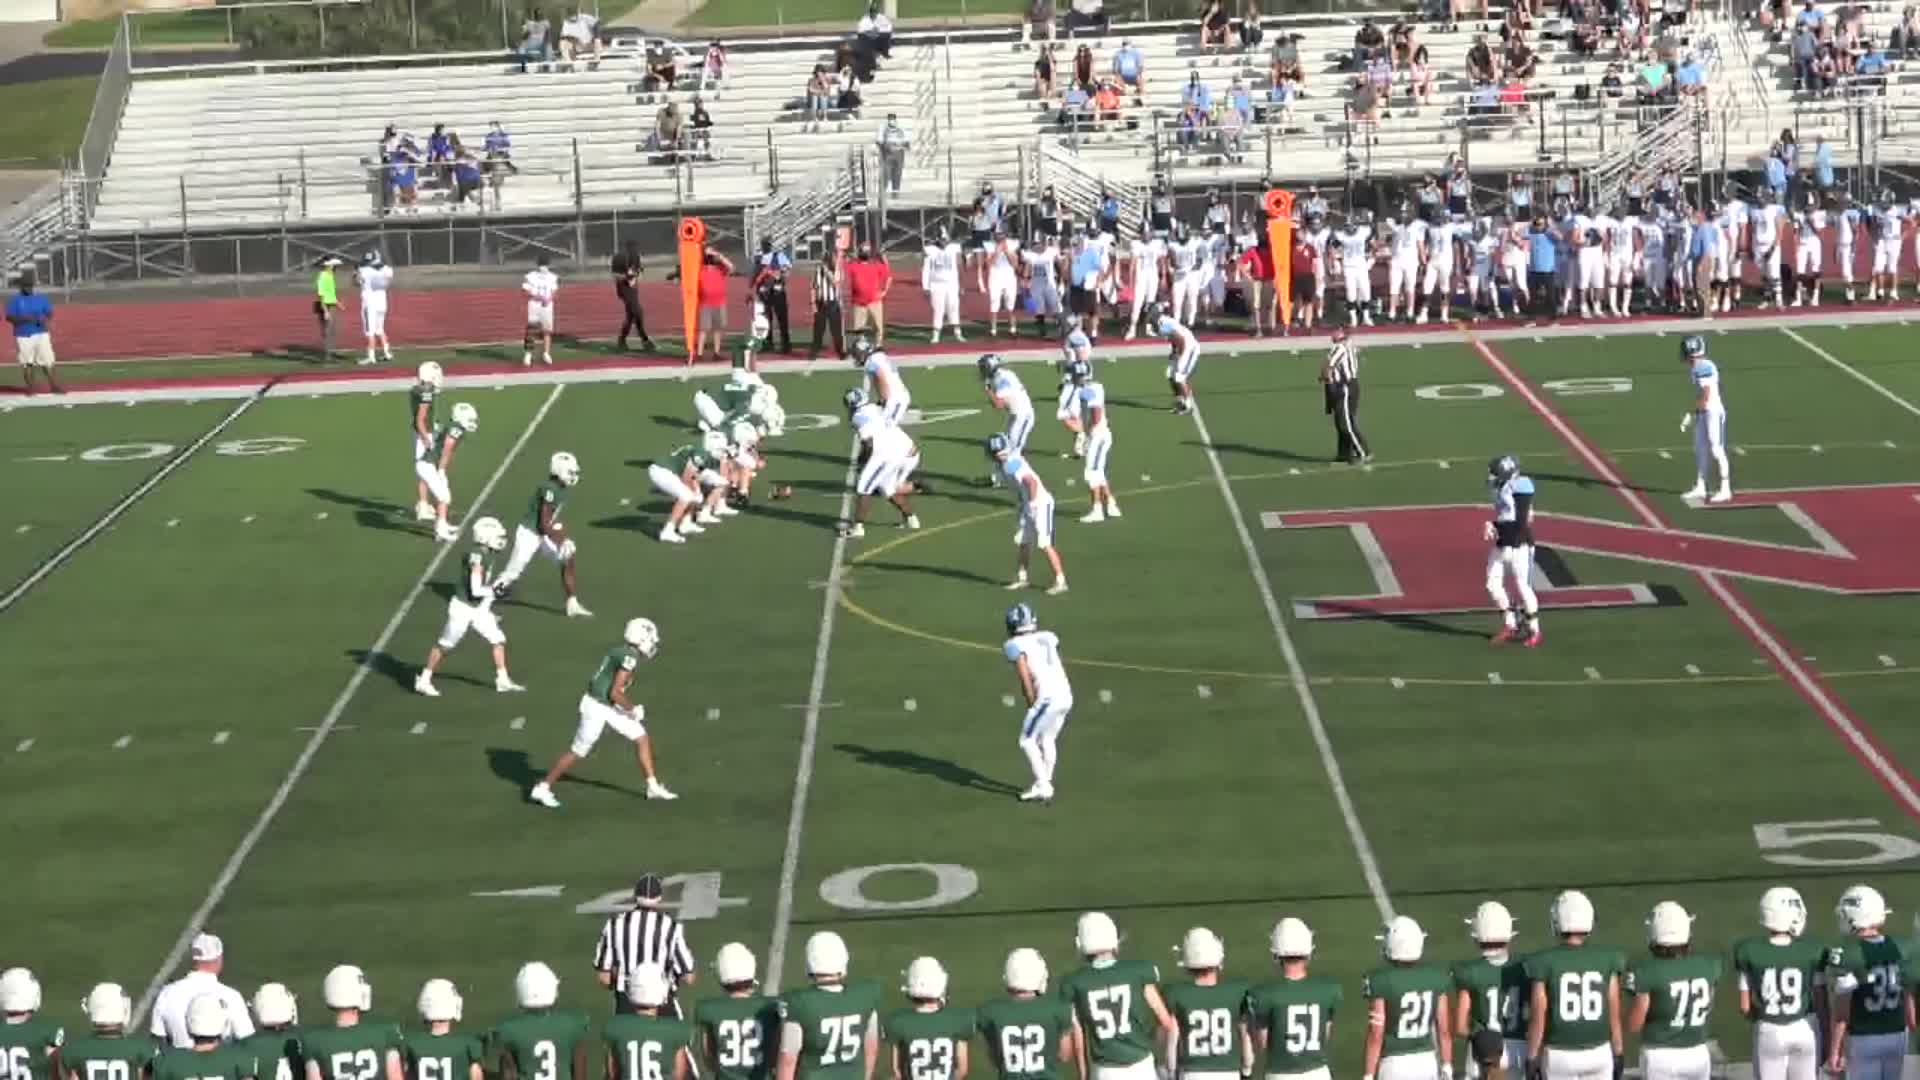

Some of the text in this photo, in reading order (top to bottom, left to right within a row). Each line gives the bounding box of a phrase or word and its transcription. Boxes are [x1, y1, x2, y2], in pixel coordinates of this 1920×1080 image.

[1087, 983, 1132, 1040] 57
[1397, 990, 1434, 1039] 21
[1559, 970, 1604, 1022] 66
[1669, 976, 1712, 1028] 72
[1761, 967, 1804, 1015] 49
[718, 1018, 763, 1067] 32
[820, 1013, 862, 1066] 75
[1001, 1024, 1046, 1073] 62
[1187, 1007, 1233, 1057] 28
[1286, 1003, 1321, 1053] 51
[533, 1039, 557, 1080] 3
[626, 1039, 664, 1080] 16
[909, 1037, 953, 1080] 23
